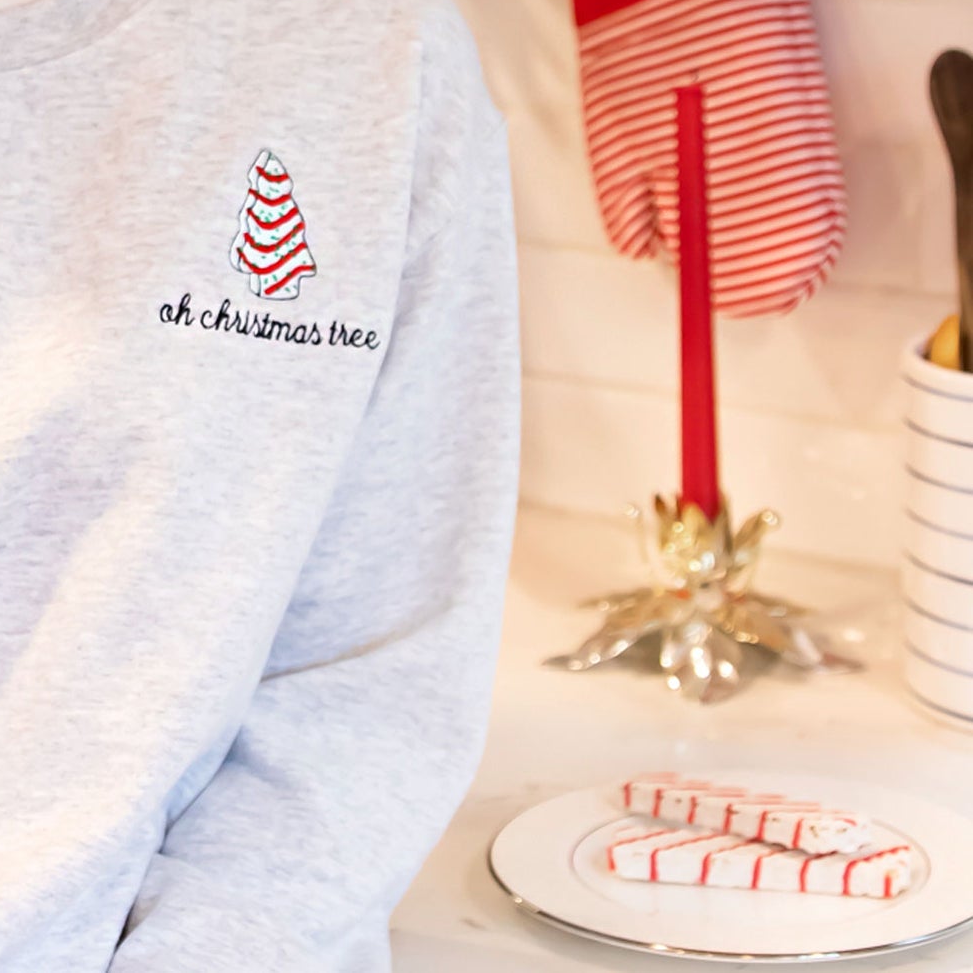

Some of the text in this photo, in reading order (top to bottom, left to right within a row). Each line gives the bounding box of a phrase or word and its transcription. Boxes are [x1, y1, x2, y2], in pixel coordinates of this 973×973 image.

[159, 292, 381, 350] oh christmas tree
